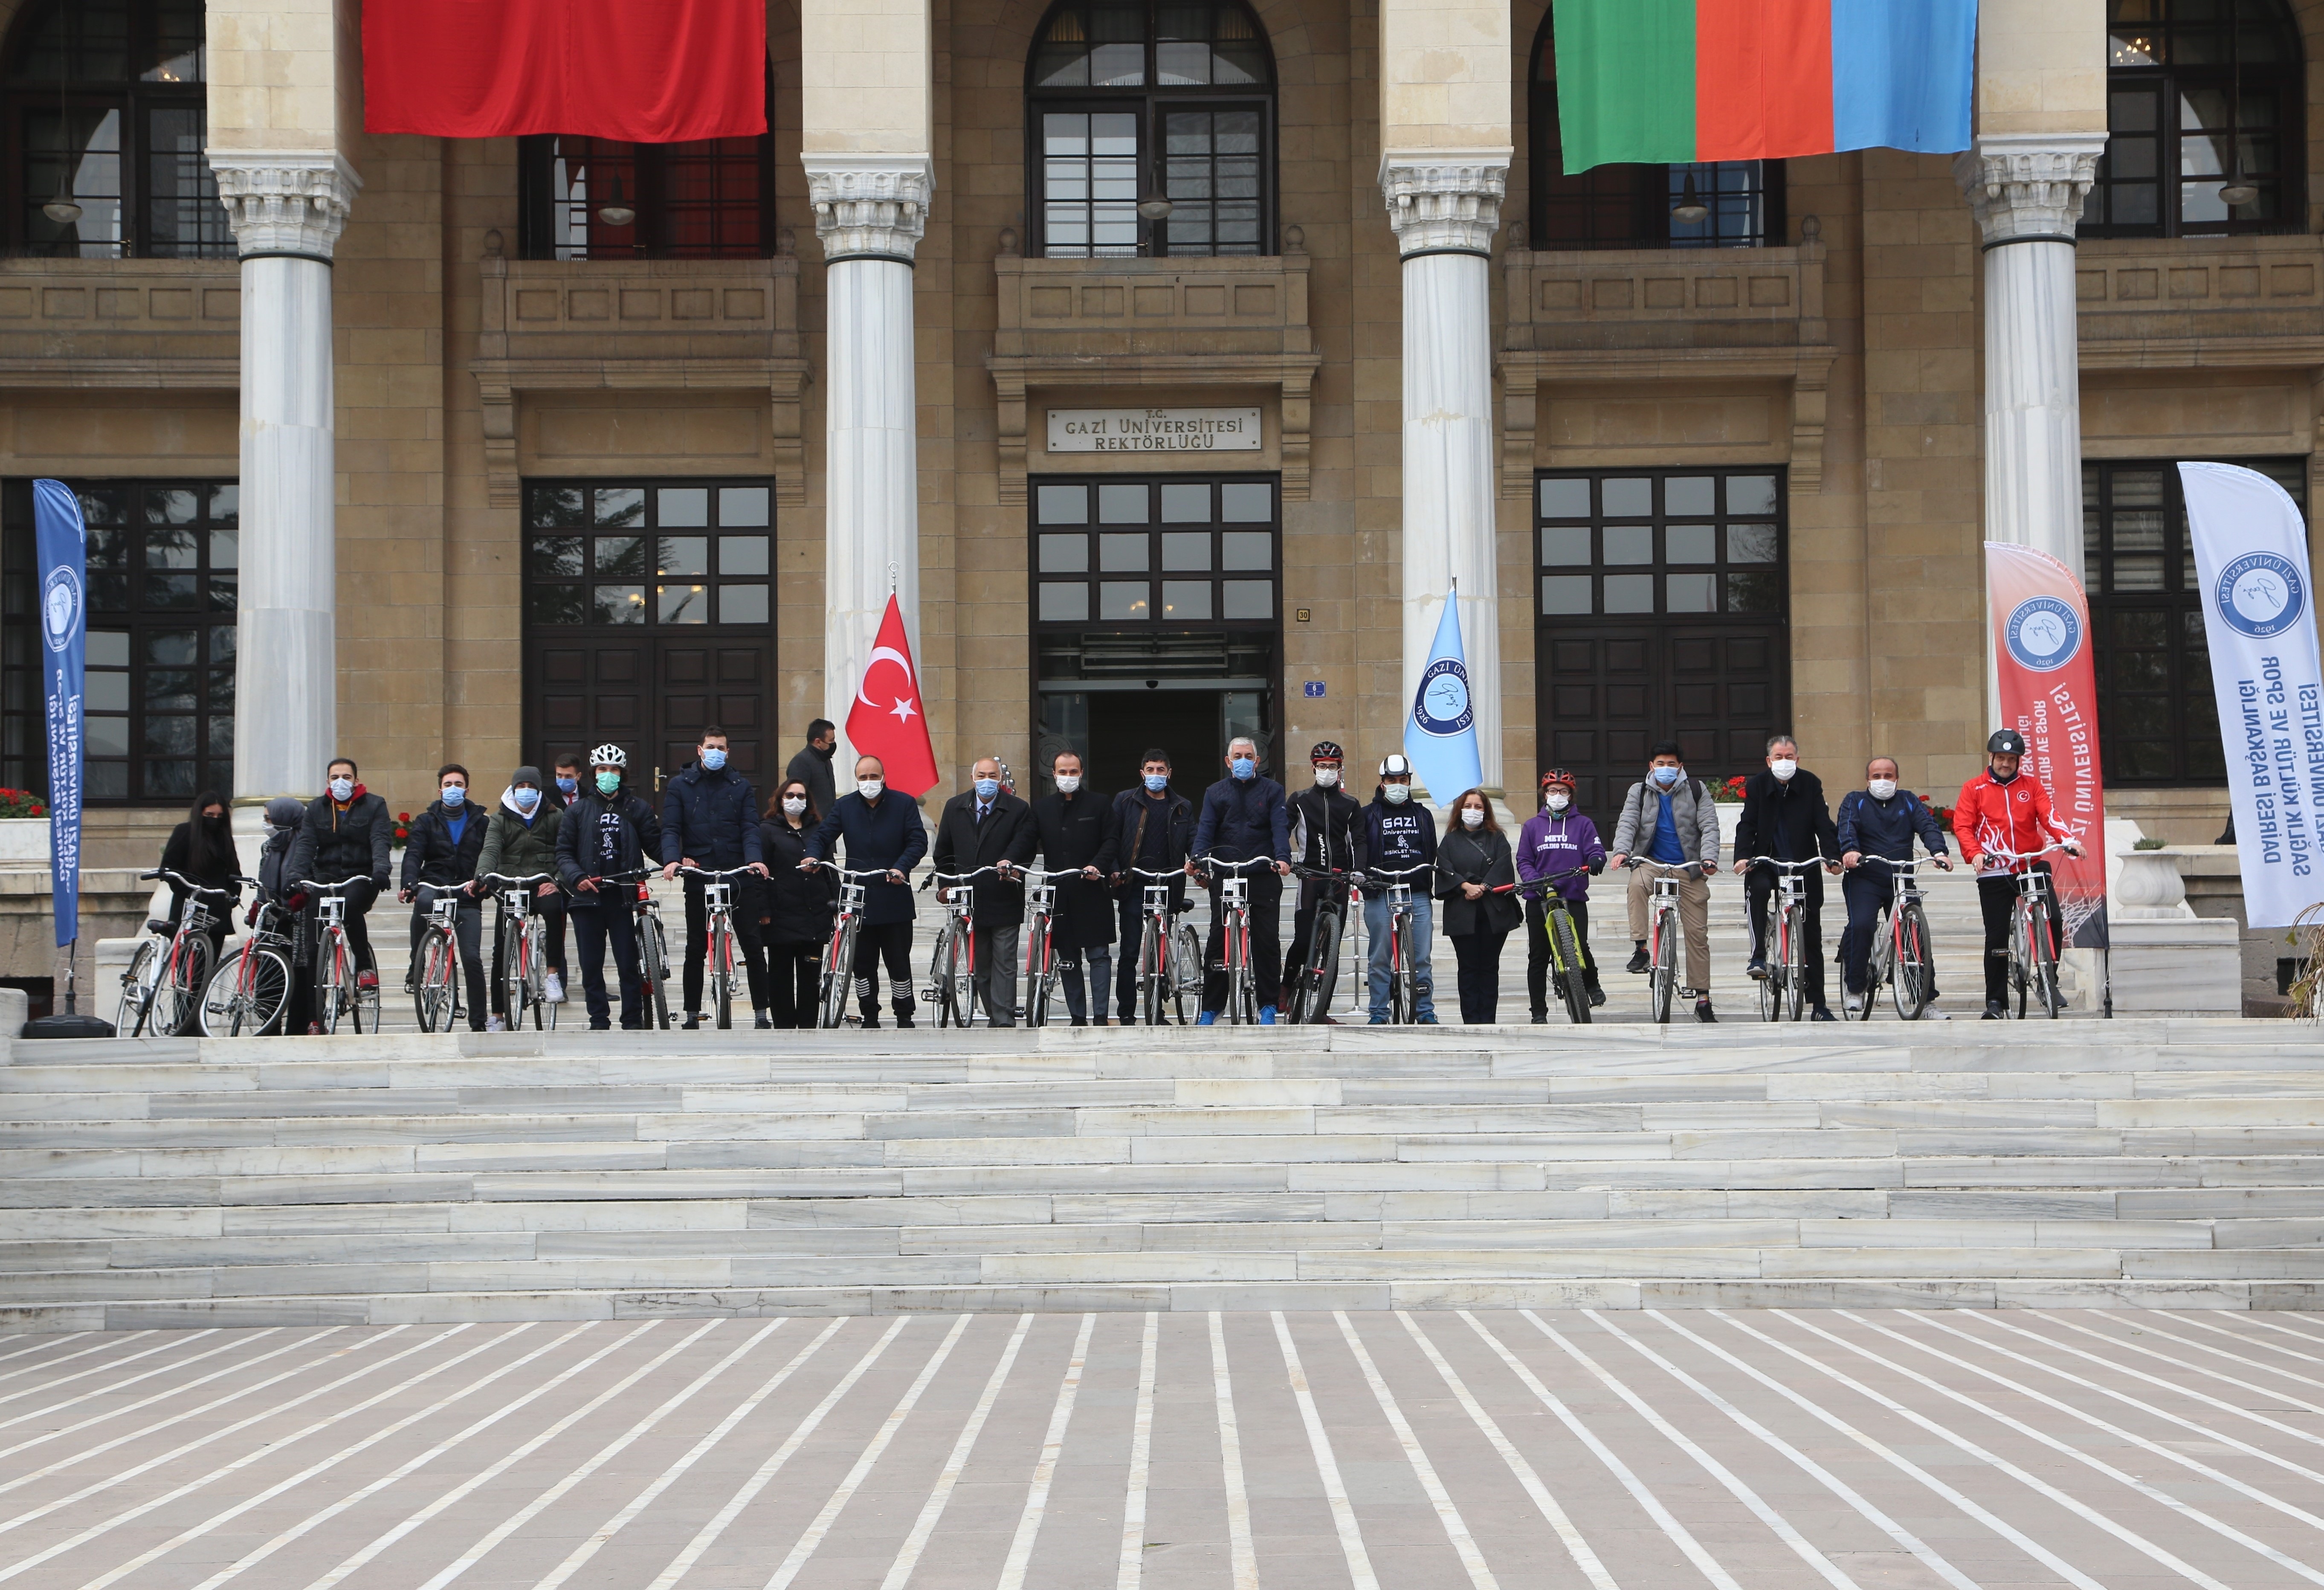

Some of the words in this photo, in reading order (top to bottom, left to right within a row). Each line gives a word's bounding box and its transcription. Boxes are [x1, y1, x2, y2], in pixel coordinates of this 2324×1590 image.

[1146, 410, 1166, 418] T.C.
[1066, 419, 1106, 434] GAZİ
[1120, 418, 1243, 434] ÜNİVERSİTESİ
[1095, 434, 1214, 450] REKTÖRLÜĞÜ
[1428, 662, 1449, 678] GAZİ
[1417, 705, 1430, 724] 1926
[600, 813, 619, 824] AZ
[1383, 816, 1416, 828] GAZİ
[1537, 843, 1559, 852] CYCLING
